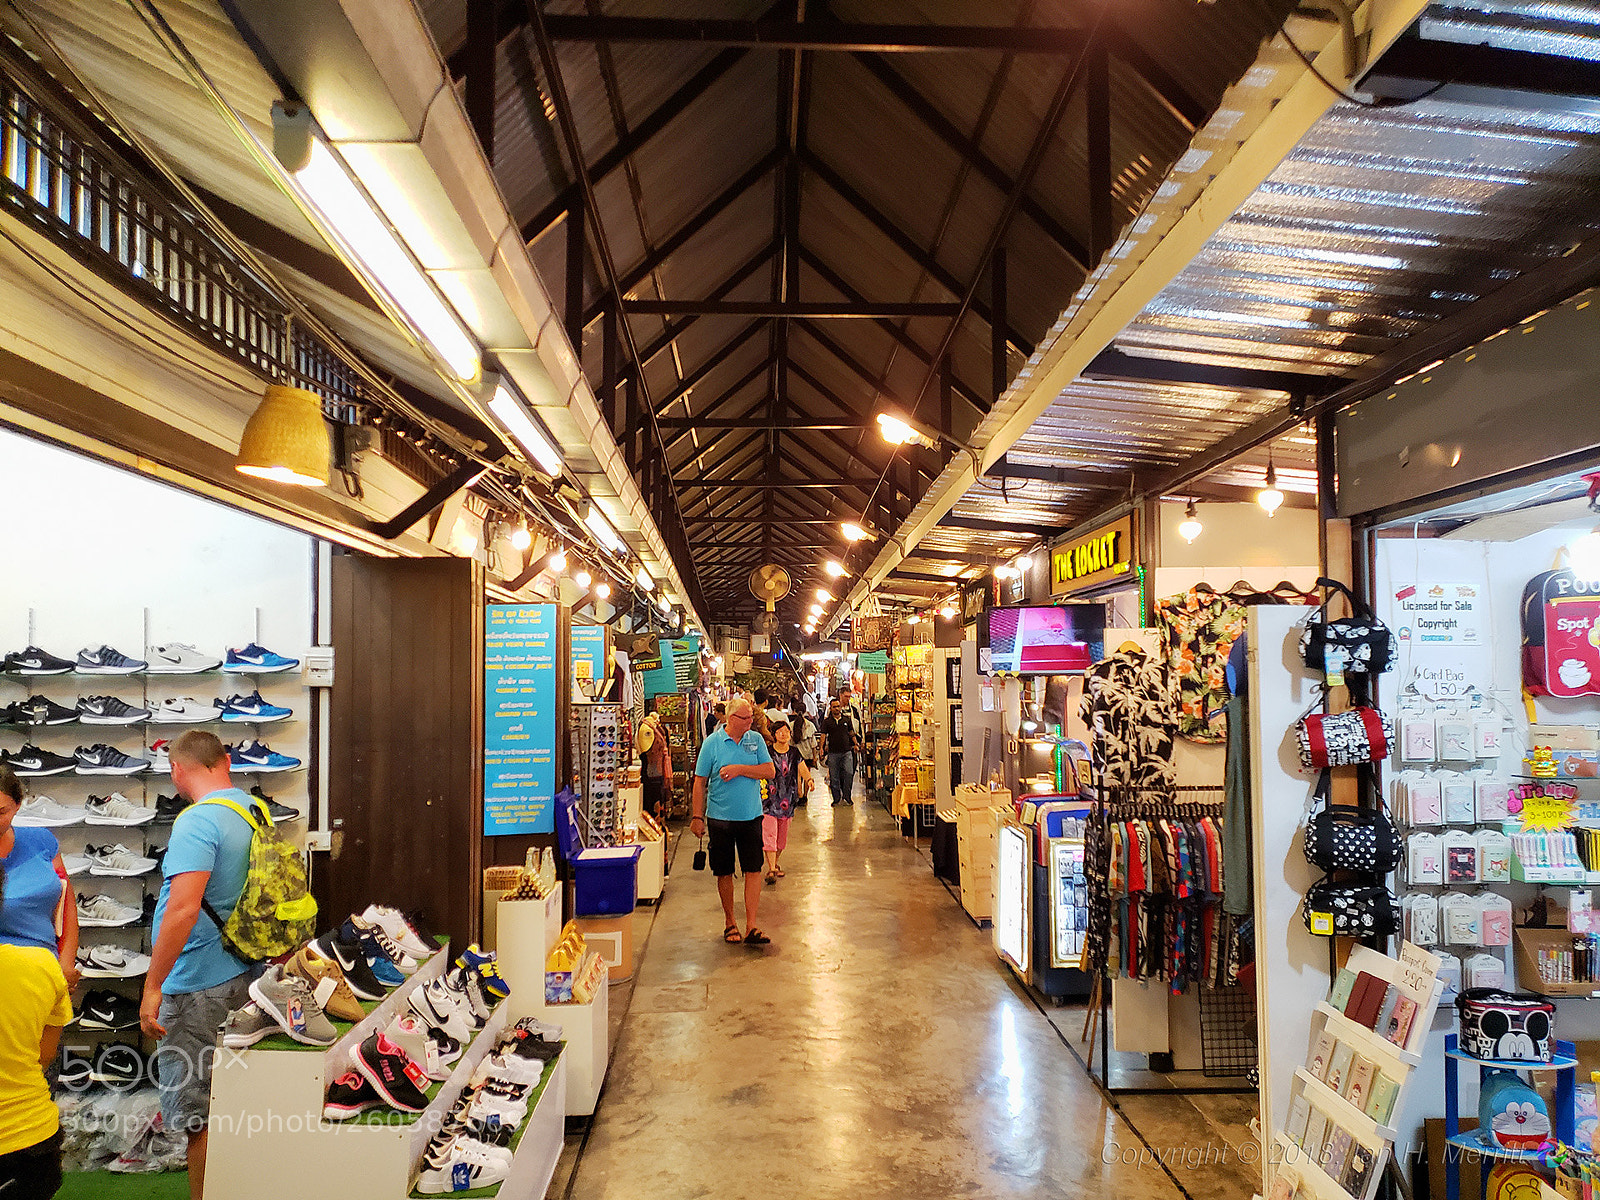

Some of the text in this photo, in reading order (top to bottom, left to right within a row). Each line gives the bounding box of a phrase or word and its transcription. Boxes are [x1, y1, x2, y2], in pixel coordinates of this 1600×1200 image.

[1054, 531, 1117, 583] THE LOCKET
[1402, 600, 1472, 611] Licensed for Sale
[1418, 617, 1458, 630] Copyright
[1557, 616, 1590, 633] Spot
[576, 666, 590, 677] 150
[635, 662, 657, 670] COTTON
[1423, 667, 1443, 680] Card
[1544, 782, 1577, 799] NEW
